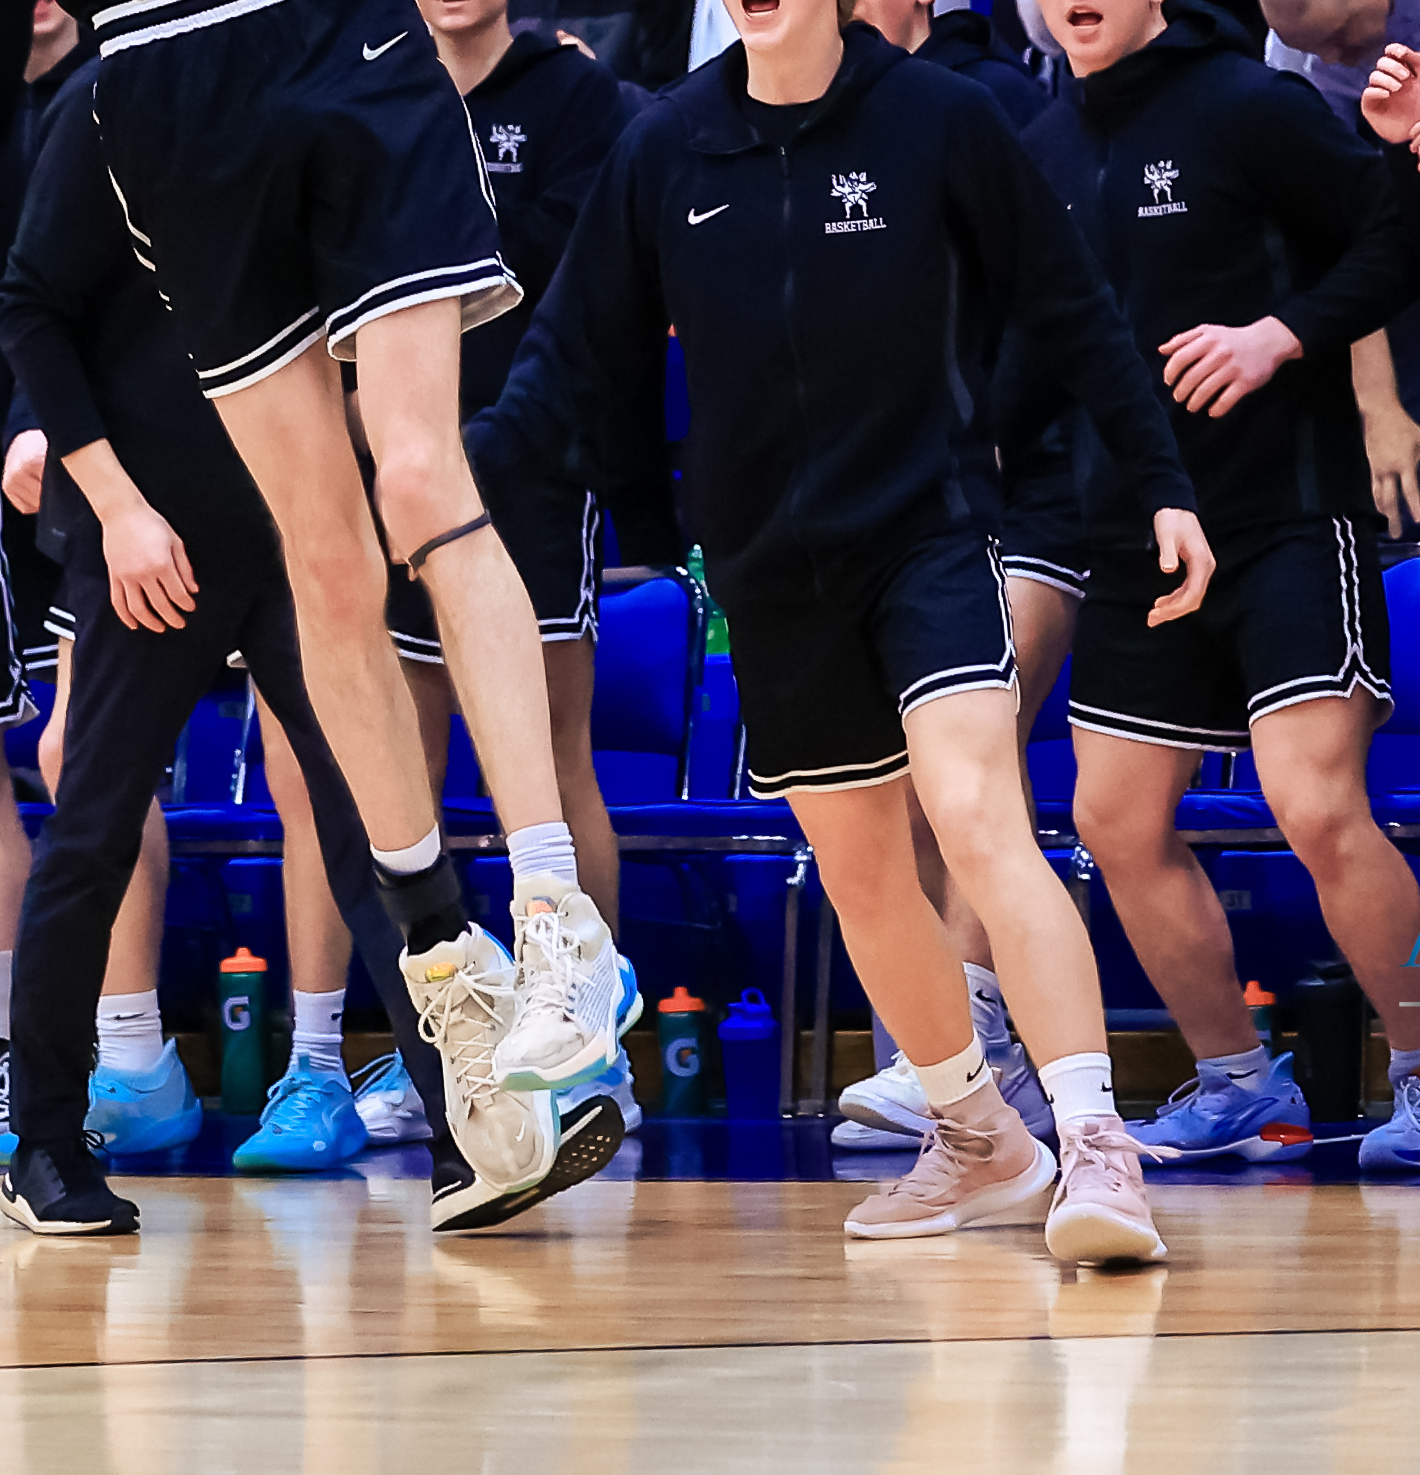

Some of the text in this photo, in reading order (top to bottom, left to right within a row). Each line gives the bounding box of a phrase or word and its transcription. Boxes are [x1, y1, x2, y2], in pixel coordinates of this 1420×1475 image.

[824, 216, 887, 234] BASKETBALL
[222, 995, 252, 1031] G
[665, 1037, 700, 1077] G
